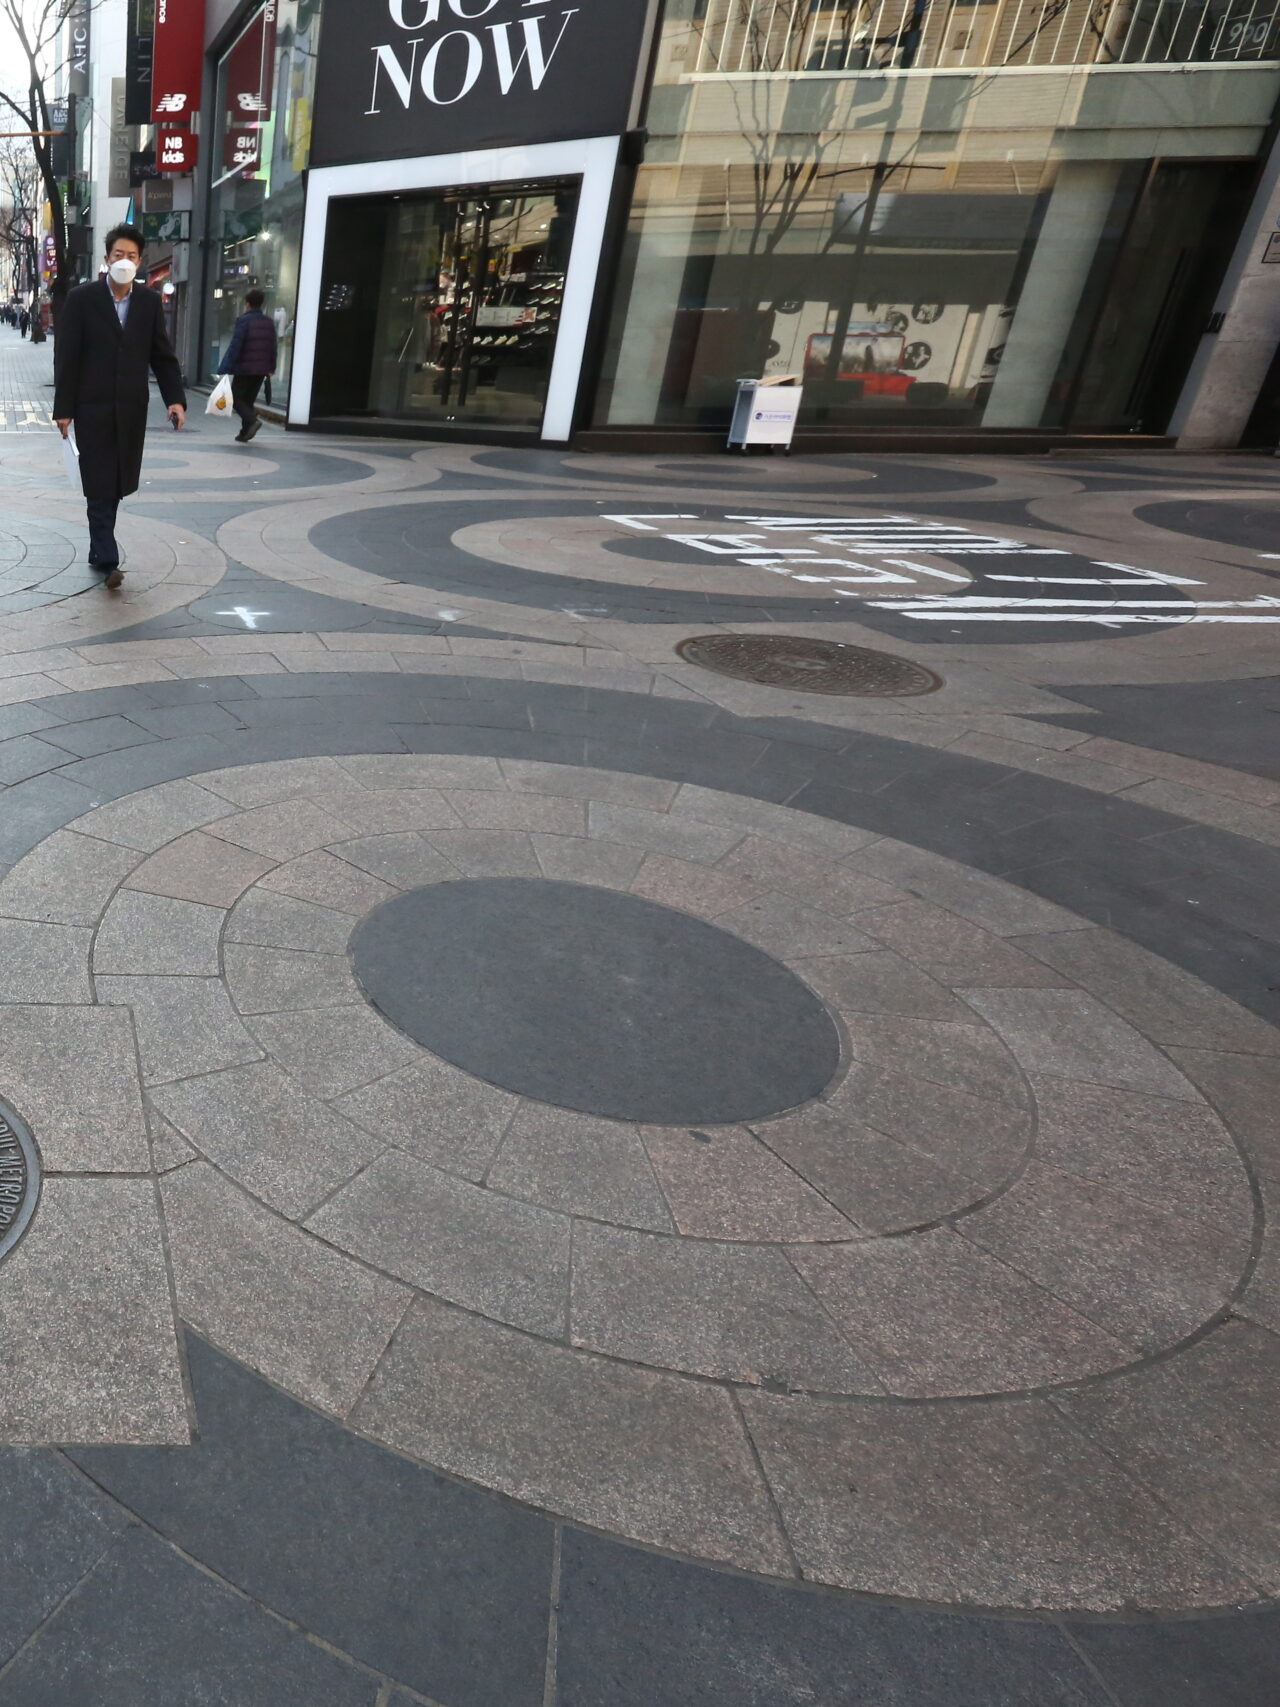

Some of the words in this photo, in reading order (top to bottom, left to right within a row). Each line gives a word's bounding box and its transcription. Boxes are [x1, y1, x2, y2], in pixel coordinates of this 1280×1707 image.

[364, 8, 580, 115] NOW
[164, 136, 183, 149] NB
[162, 150, 185, 163] kids
